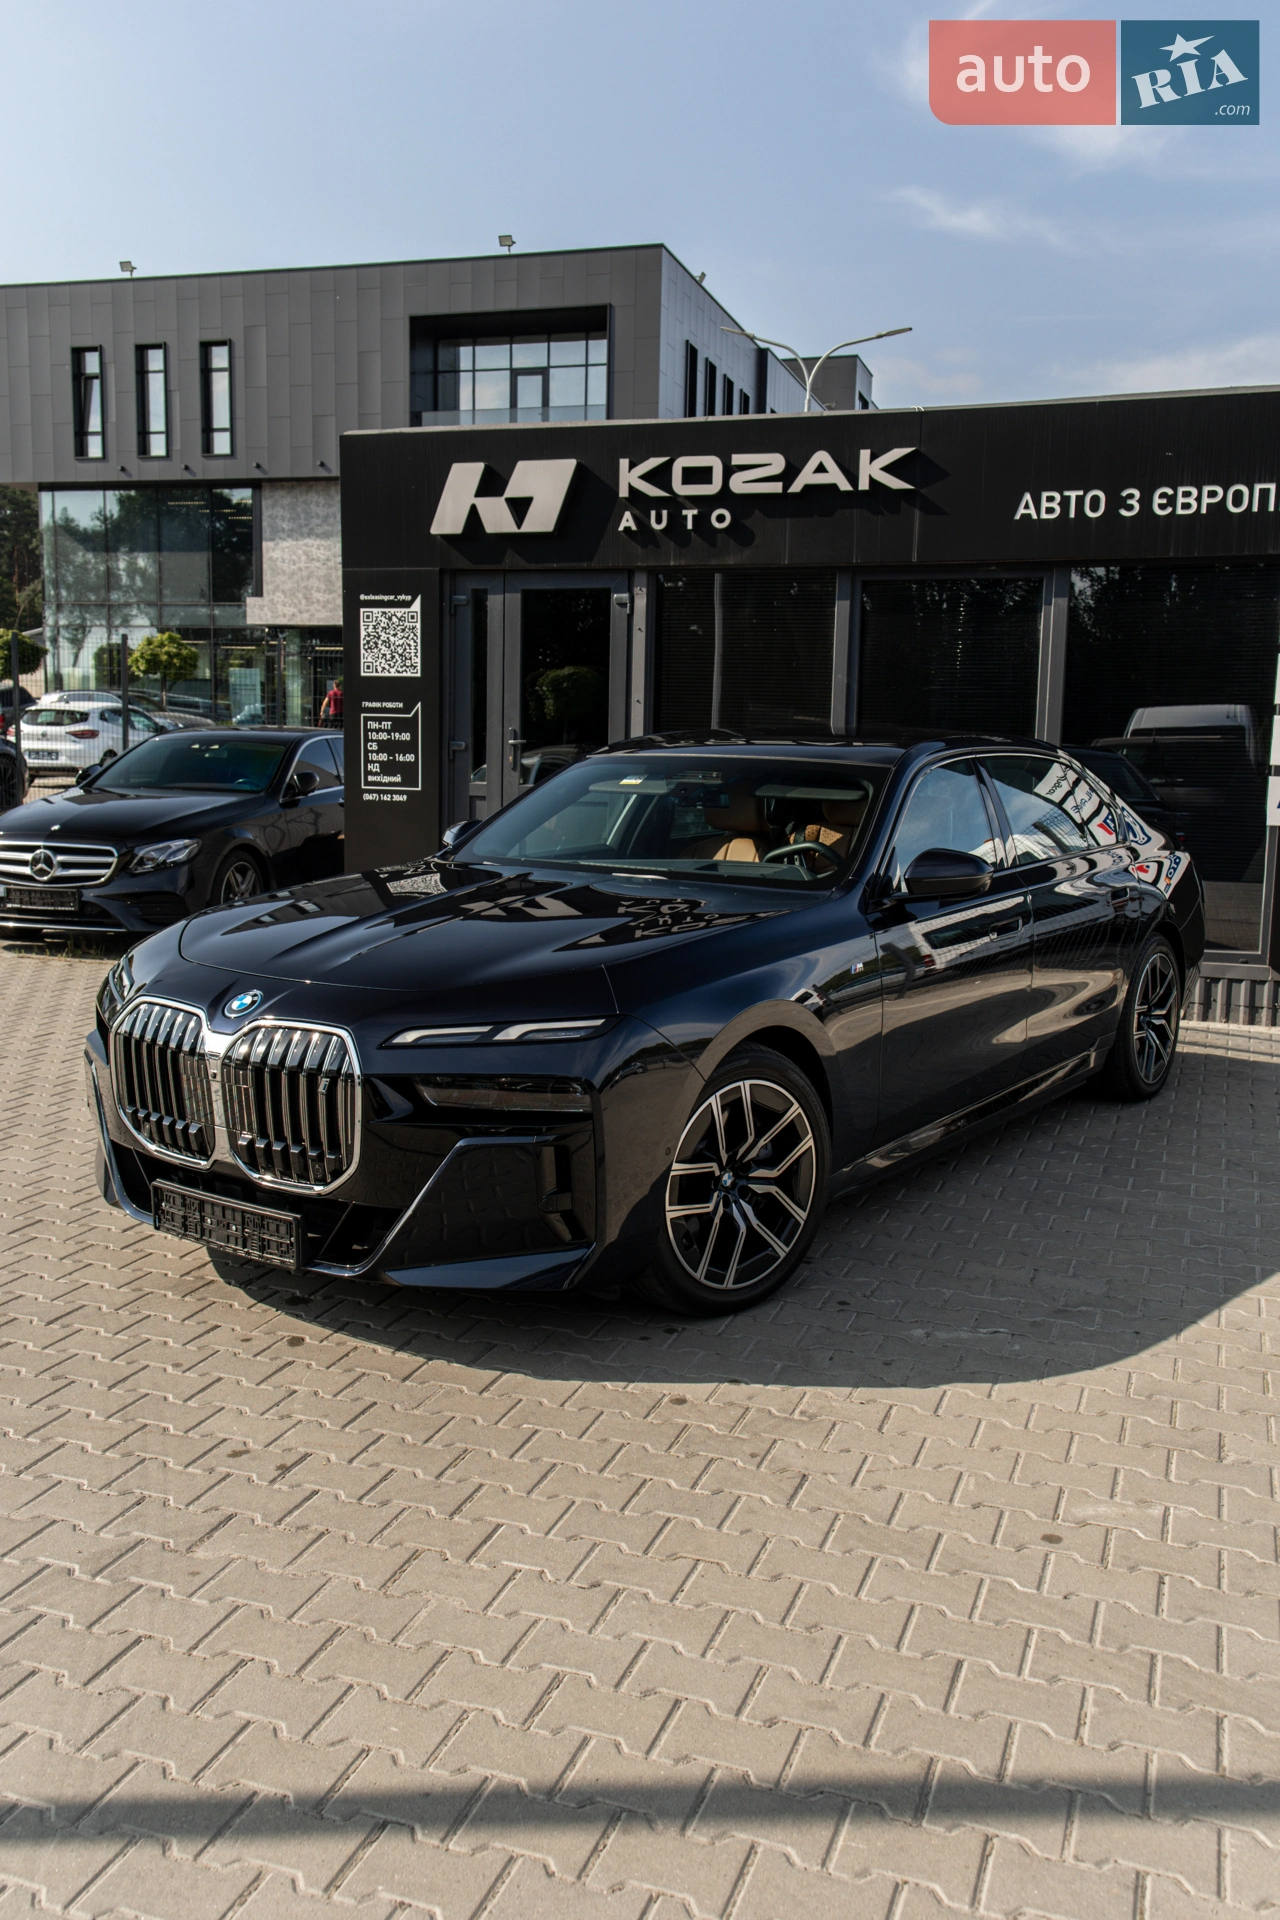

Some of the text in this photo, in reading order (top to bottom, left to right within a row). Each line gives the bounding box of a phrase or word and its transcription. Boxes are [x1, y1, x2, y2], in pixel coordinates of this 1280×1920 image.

[618, 447, 918, 498] KOZAK
[1013, 489, 1106, 520] АВТО
[1151, 482, 1280, 516] ЄВРОП
[617, 508, 732, 532] AUTO
[367, 720, 392, 730] ПН-ПТ
[367, 731, 411, 742] 10:00-19:00
[367, 741, 378, 751] СБ
[367, 752, 388, 762] 10:00
[394, 753, 416, 763] 16:00
[367, 763, 381, 773] НД
[367, 773, 402, 784] вихідний
[363, 792, 380, 802] (067)
[380, 793, 392, 802] 162
